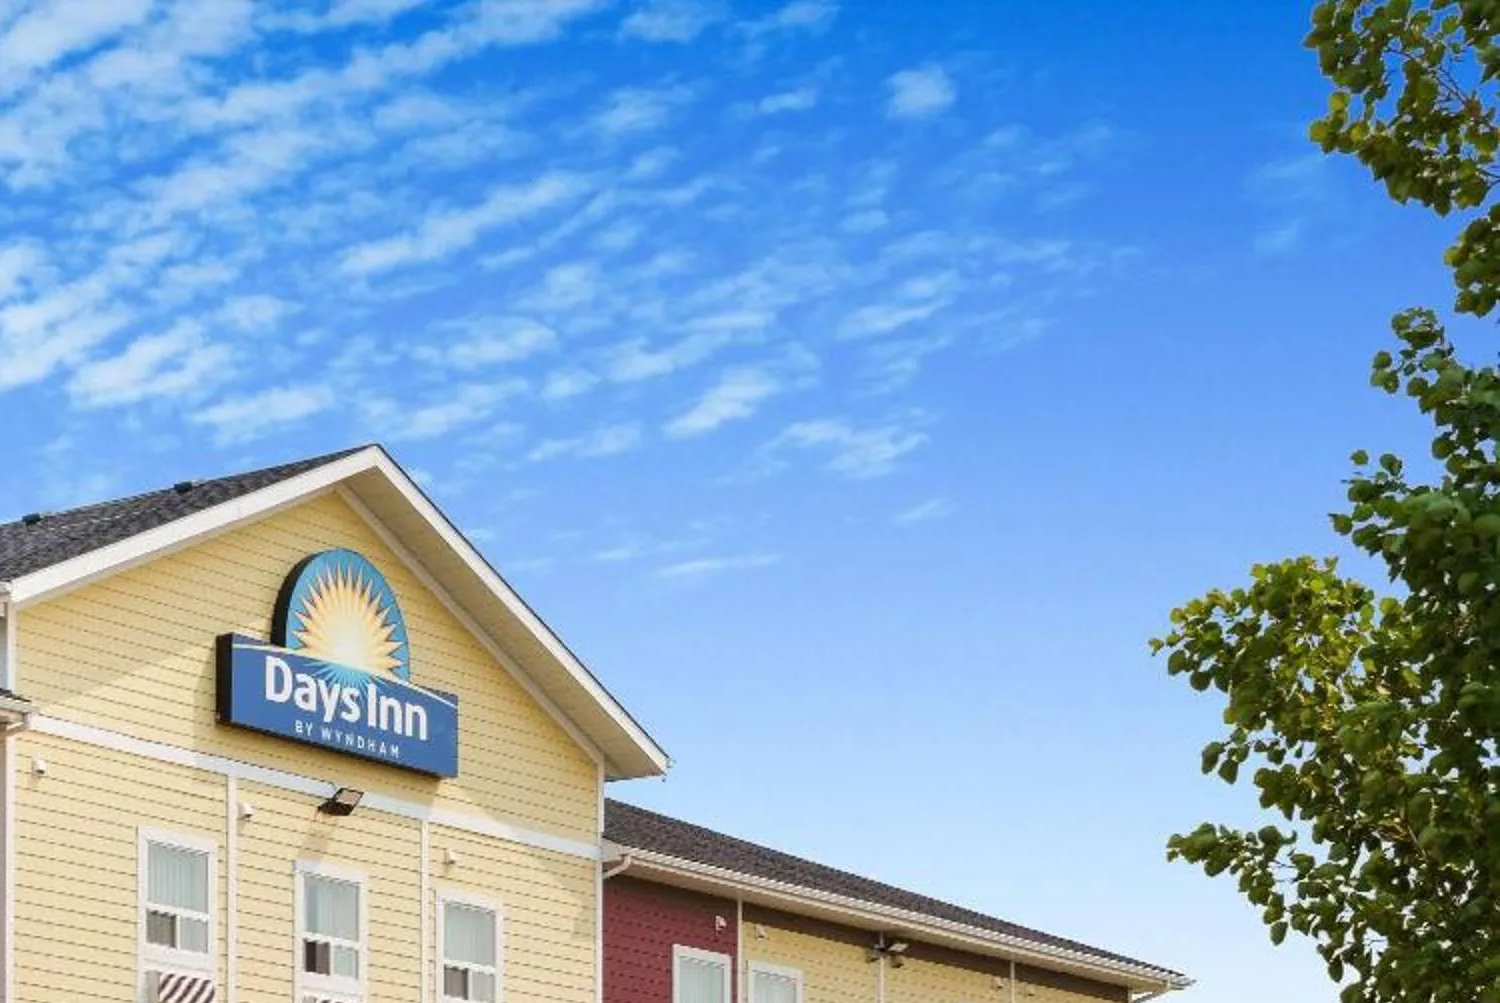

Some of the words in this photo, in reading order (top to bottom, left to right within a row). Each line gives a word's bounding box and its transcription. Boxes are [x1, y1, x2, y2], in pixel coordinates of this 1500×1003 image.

[265, 655, 361, 723] Days
[368, 683, 428, 741] Inn
[295, 720, 313, 736] BY
[322, 726, 400, 758] WYNDHAM
